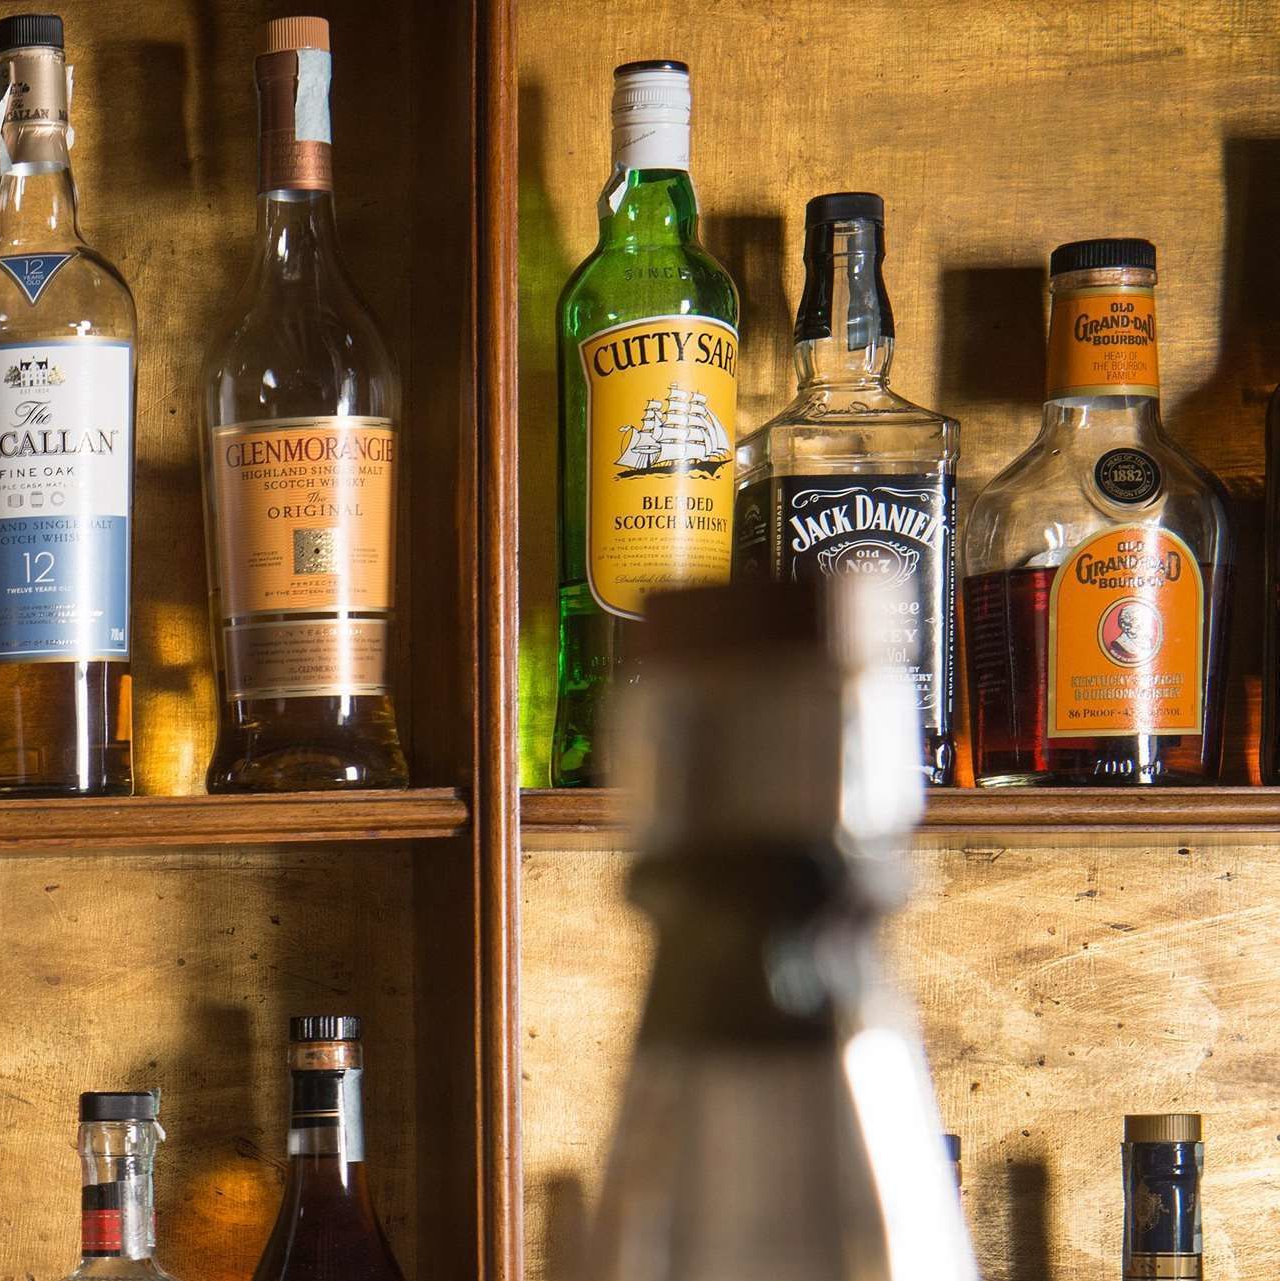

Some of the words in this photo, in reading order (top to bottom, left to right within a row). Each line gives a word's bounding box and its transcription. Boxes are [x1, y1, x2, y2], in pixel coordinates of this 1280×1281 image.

[24, 259, 43, 275] 12
[1110, 302, 1135, 313] OLD
[1092, 335, 1148, 346] BOURBON
[593, 331, 693, 378] CUTTY
[1093, 362, 1108, 371] THE
[1111, 361, 1147, 371] BOURBON
[1106, 371, 1137, 380] FAMILY
[11, 400, 53, 428] The
[225, 437, 393, 469] GLENMORANGIE
[0, 467, 37, 480] FINE
[43, 466, 75, 478] OAK
[241, 467, 307, 480] HIGHLAND
[358, 466, 383, 476] MALT
[1111, 469, 1143, 483] 1882
[20, 482, 42, 490] CASK
[264, 479, 315, 490] SCOTCH
[306, 491, 328, 504] The
[642, 496, 714, 512] BLEDED
[267, 503, 364, 520] ORIGINAL
[614, 515, 677, 530] SCOTCH
[684, 516, 728, 533] WHISKY
[789, 503, 855, 553] JACK
[42, 534, 80, 545] WHIS
[856, 550, 880, 558] Old
[23, 551, 55, 583] 12
[6, 586, 33, 594] TWELVE
[35, 585, 57, 593] YEARS
[887, 648, 911, 663] Vol.
[1071, 674, 1131, 687] KENTUCKY
[1074, 687, 1129, 701] BOURBON
[1068, 709, 1082, 719] 86
[1083, 708, 1116, 718] PROOF
